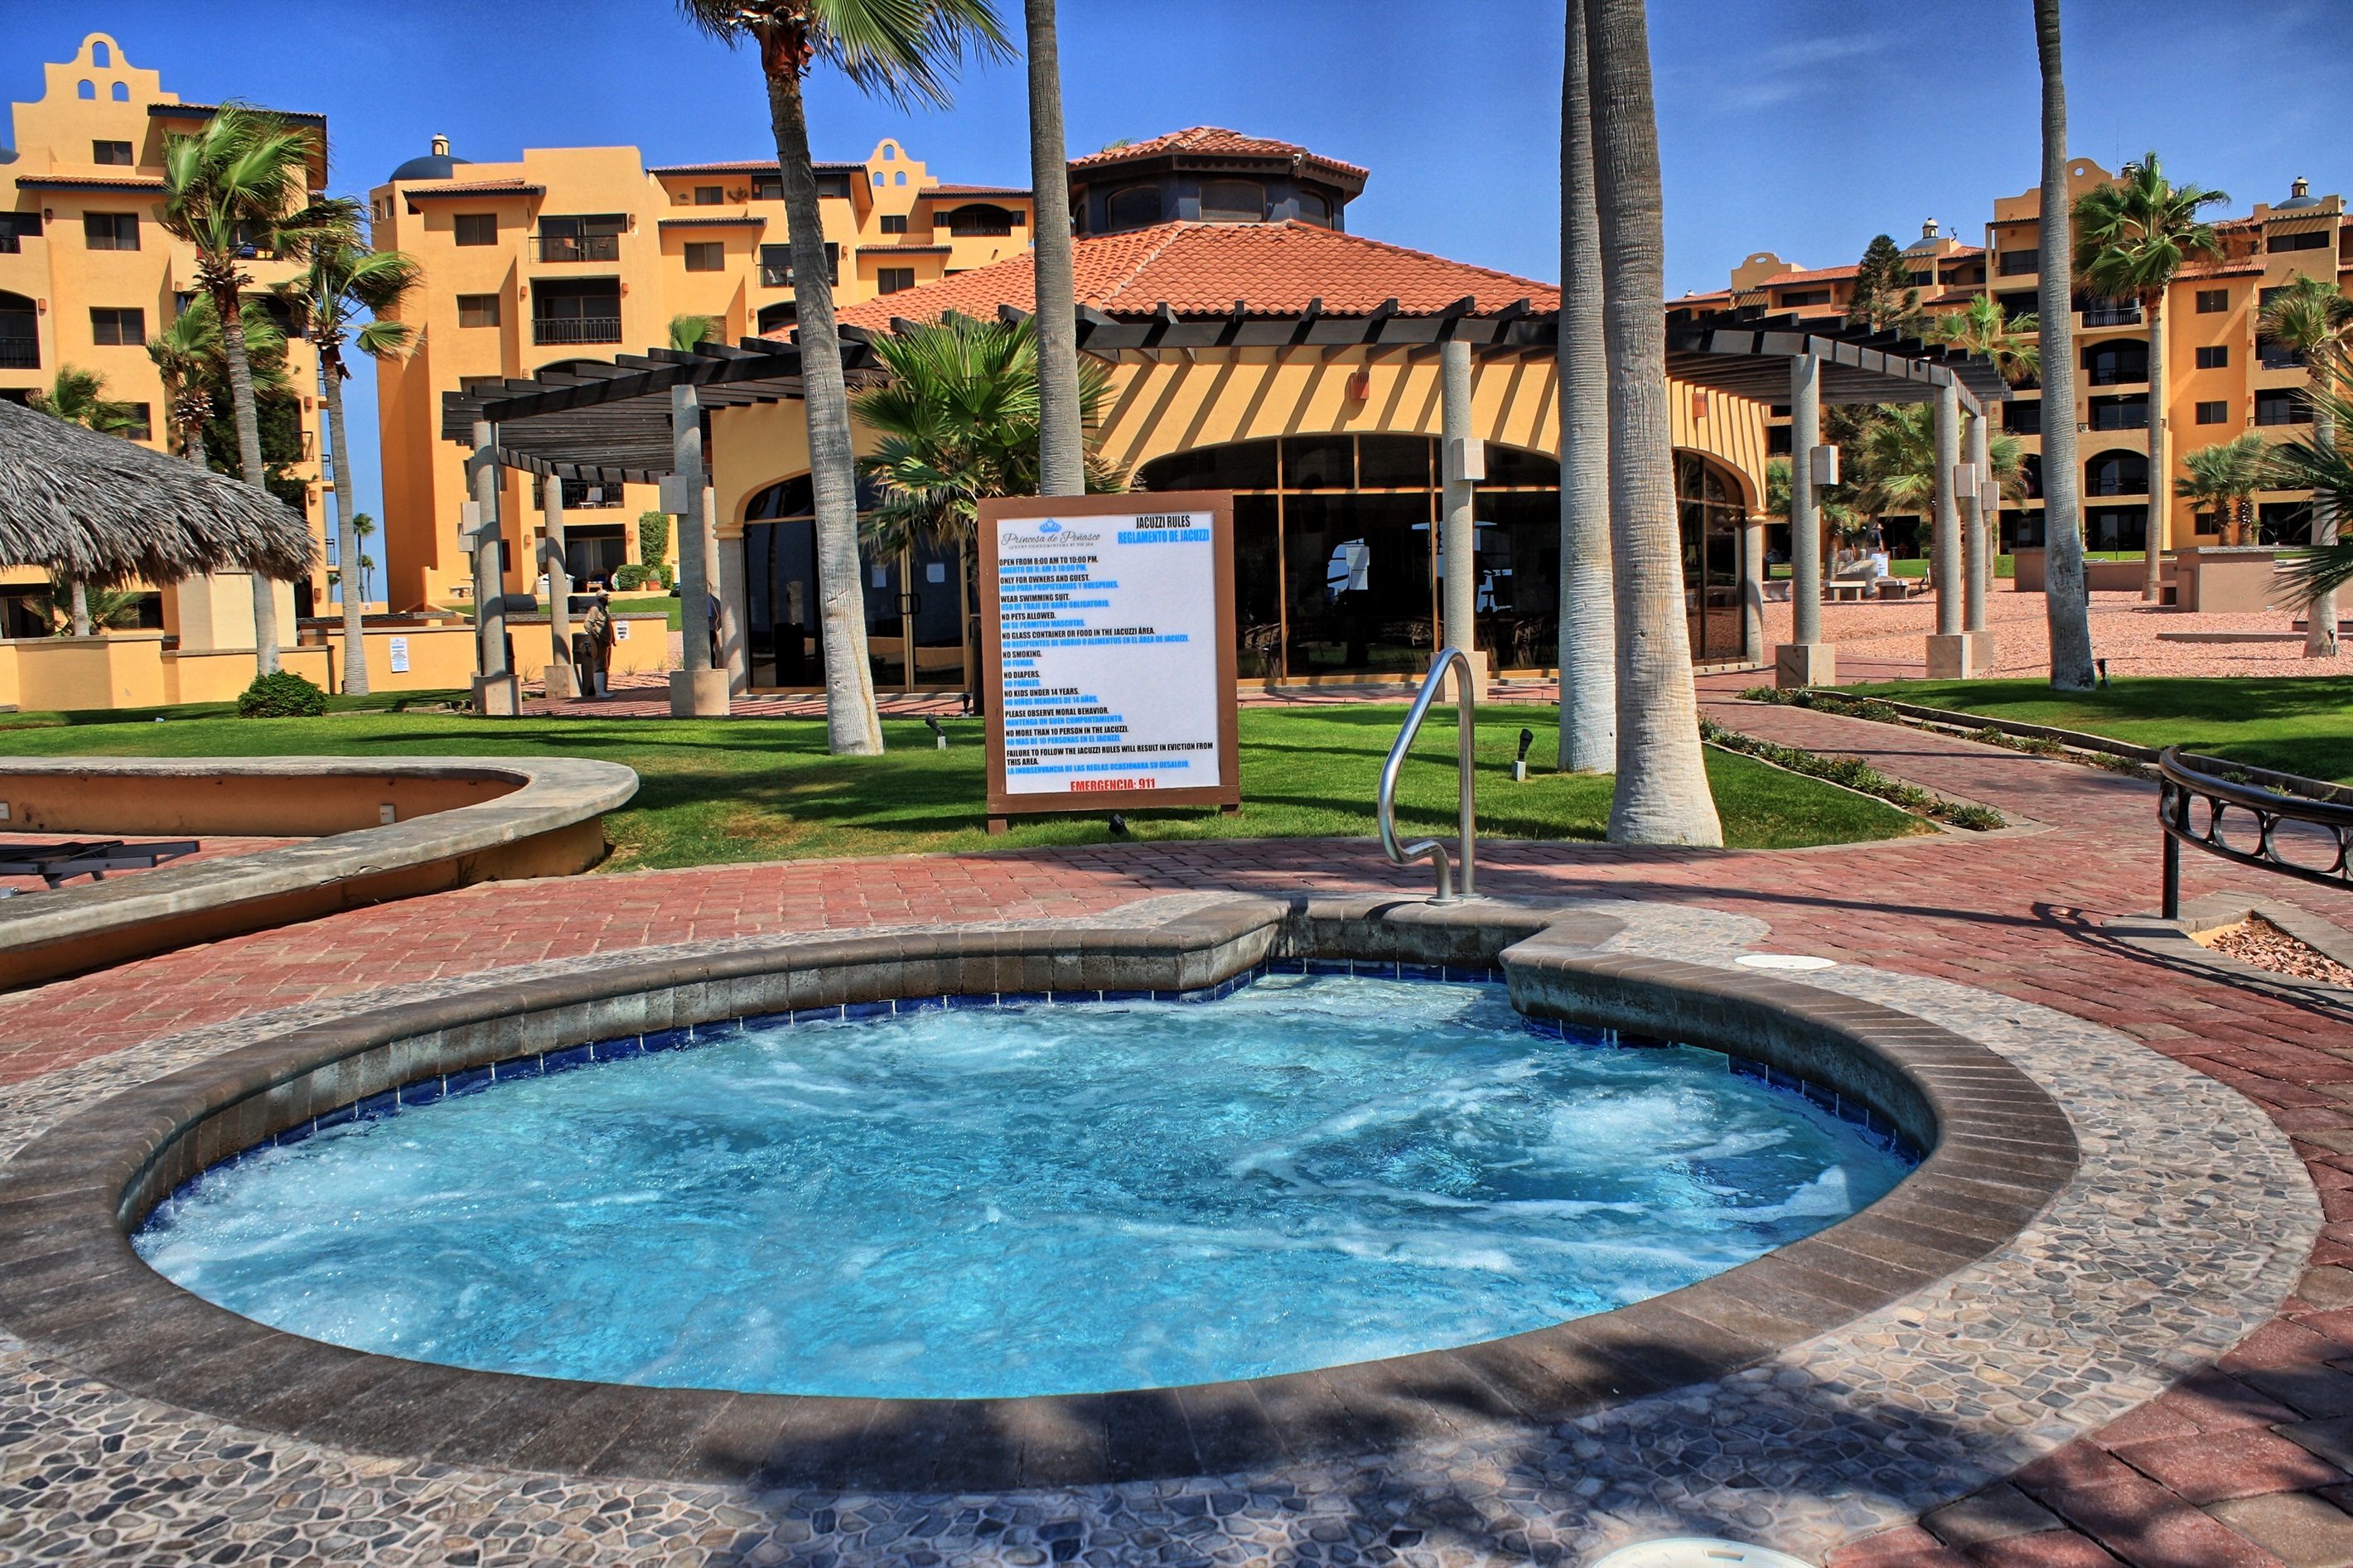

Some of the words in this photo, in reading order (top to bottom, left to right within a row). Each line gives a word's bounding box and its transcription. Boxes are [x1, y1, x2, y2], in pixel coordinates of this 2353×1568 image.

[1136, 517, 1165, 529] JACUZZI
[1167, 515, 1190, 527] RULES
[1001, 533, 1045, 545] Princesa
[1060, 531, 1100, 543] Peñasco
[1118, 531, 1167, 544] REGLAMENTO
[1170, 530, 1178, 542] DE
[1180, 529, 1209, 541] JACUZZI
[1139, 635, 1154, 643] ÁREA
[1014, 697, 1033, 705] NIÑOS
[1066, 715, 1123, 724] COMPORTAMIENTO.
[1016, 766, 1064, 774] INOBSERVANCIA
[1160, 760, 1190, 769] DESALOJO.
[1070, 779, 1136, 792] EMERGENCIA:
[1139, 778, 1155, 789] 911
